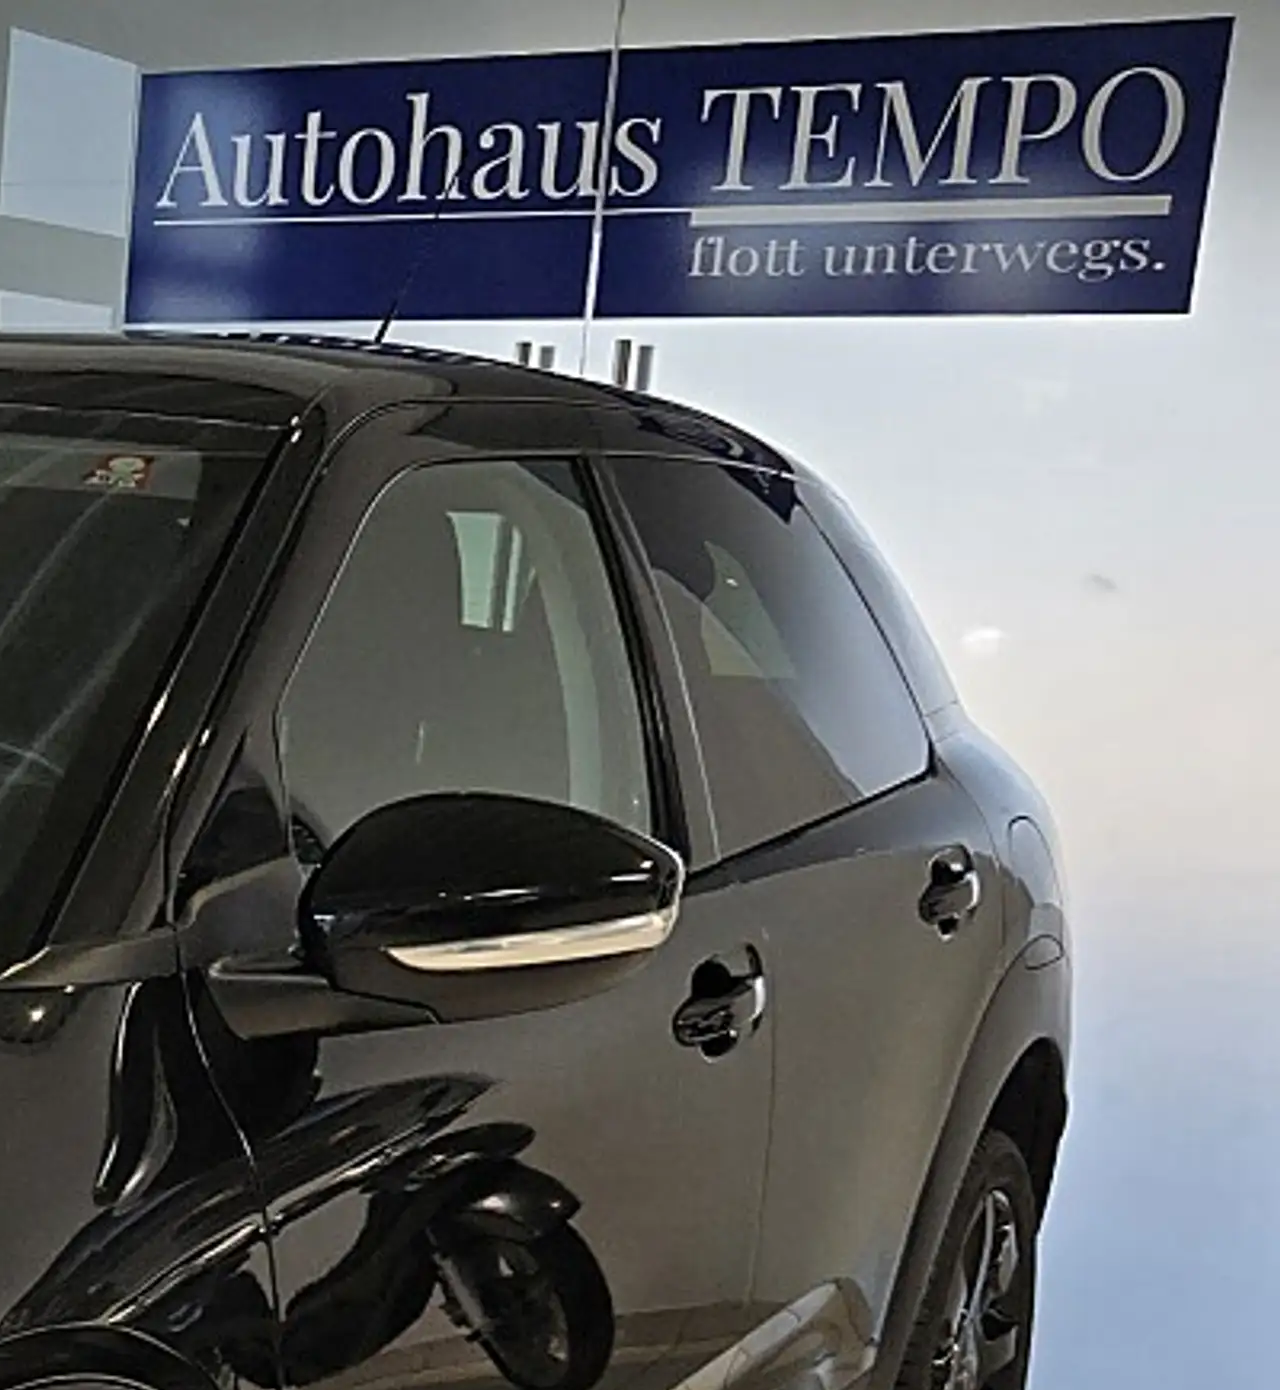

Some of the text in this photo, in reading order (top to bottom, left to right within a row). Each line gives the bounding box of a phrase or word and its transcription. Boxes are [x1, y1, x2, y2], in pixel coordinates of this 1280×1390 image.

[155, 66, 1186, 208] Autohaus TEMPO
[688, 234, 1167, 286] flott unterwegs.
